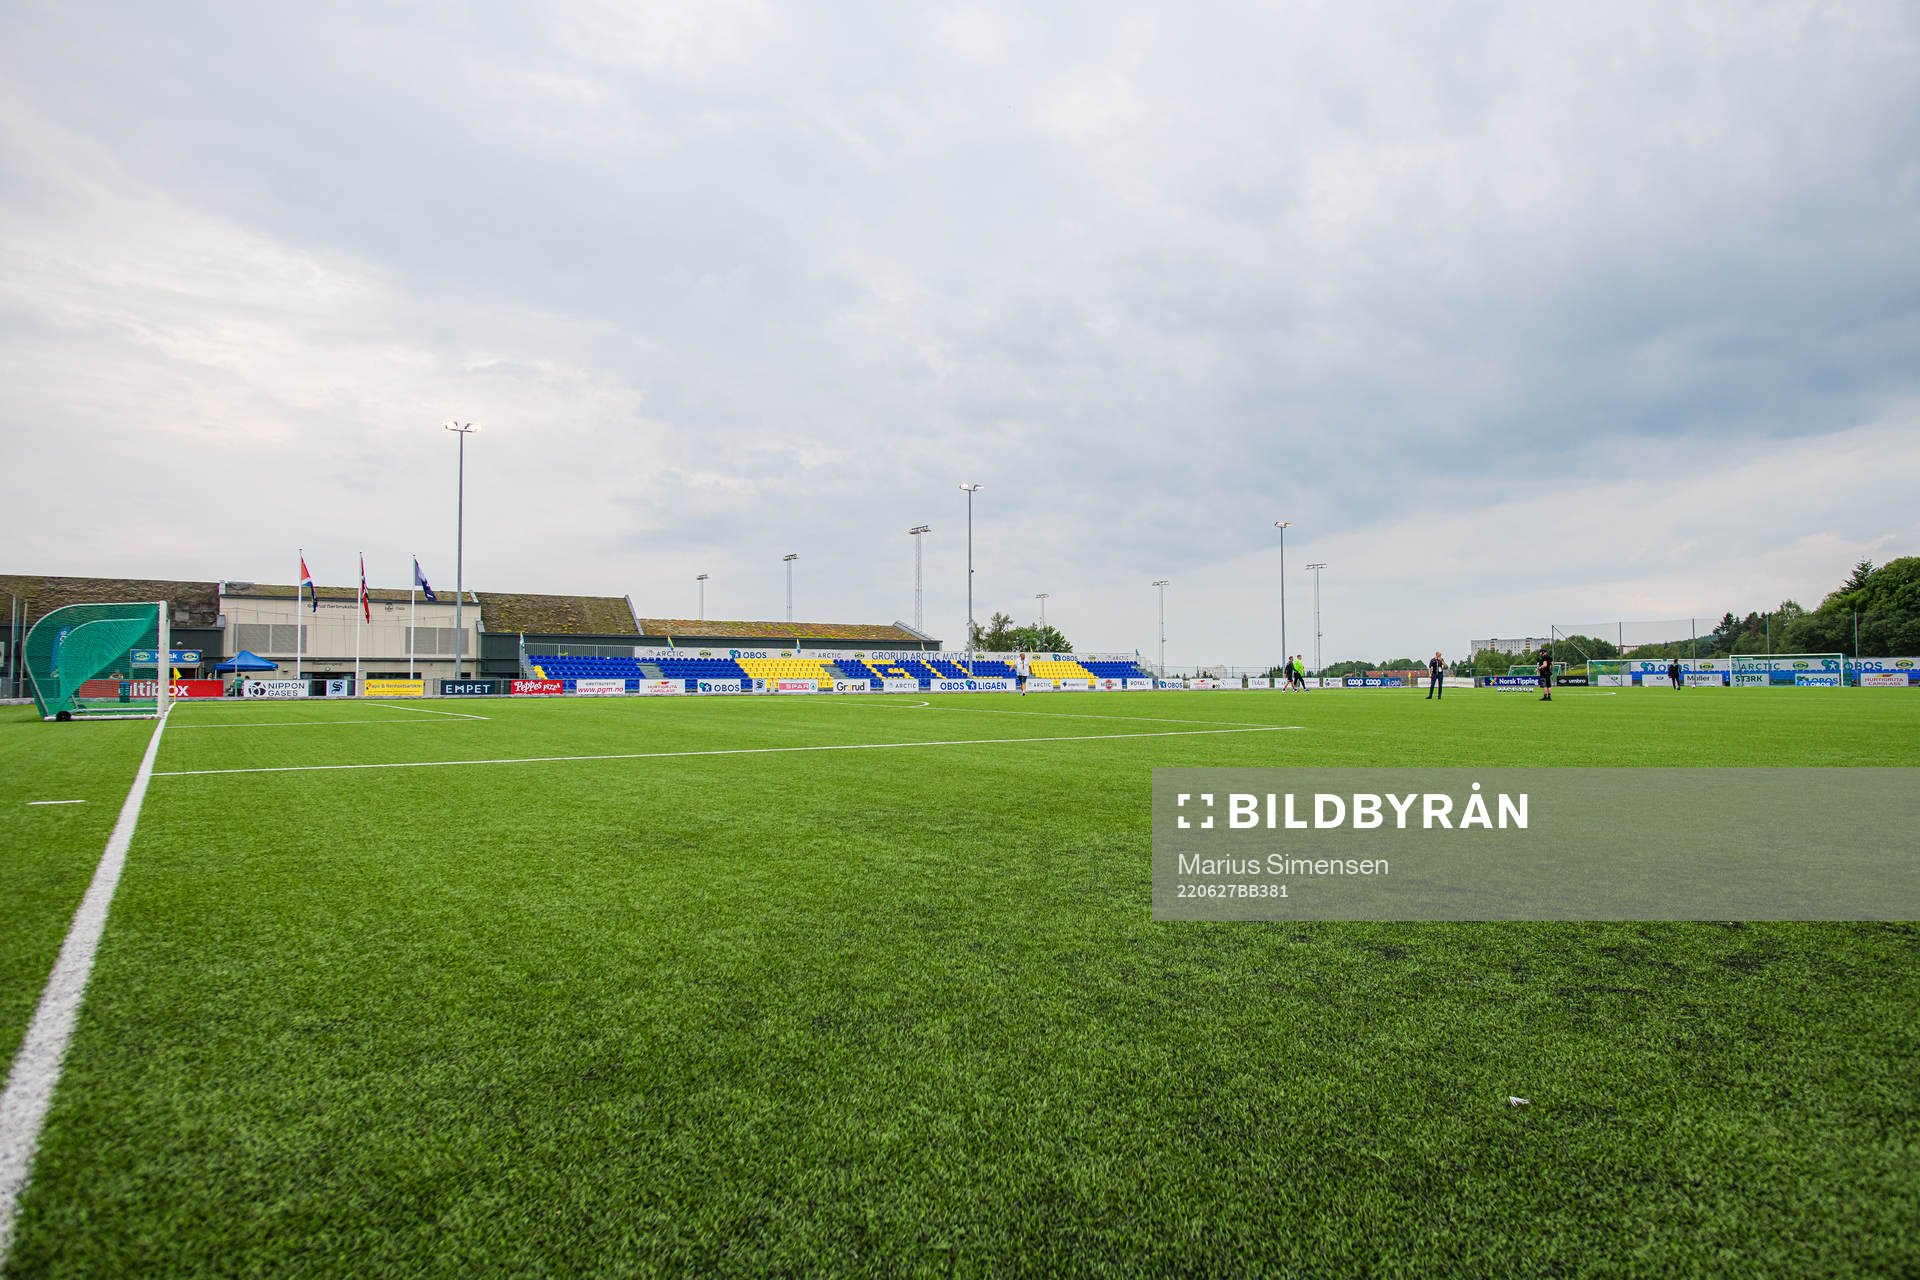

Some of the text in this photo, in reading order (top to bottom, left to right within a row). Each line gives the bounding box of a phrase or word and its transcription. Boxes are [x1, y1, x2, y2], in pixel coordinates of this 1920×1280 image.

[871, 651, 970, 660] GRORUD ARCTIC MATCH
[1843, 661, 1883, 670] OBOS
[1347, 679, 1364, 687] coop
[1365, 679, 1382, 687] coop
[1517, 677, 1539, 685] Tipping
[268, 682, 305, 690] NIPPON
[714, 684, 740, 692] OBOS
[940, 682, 1007, 690] OBOS LIGAEN
